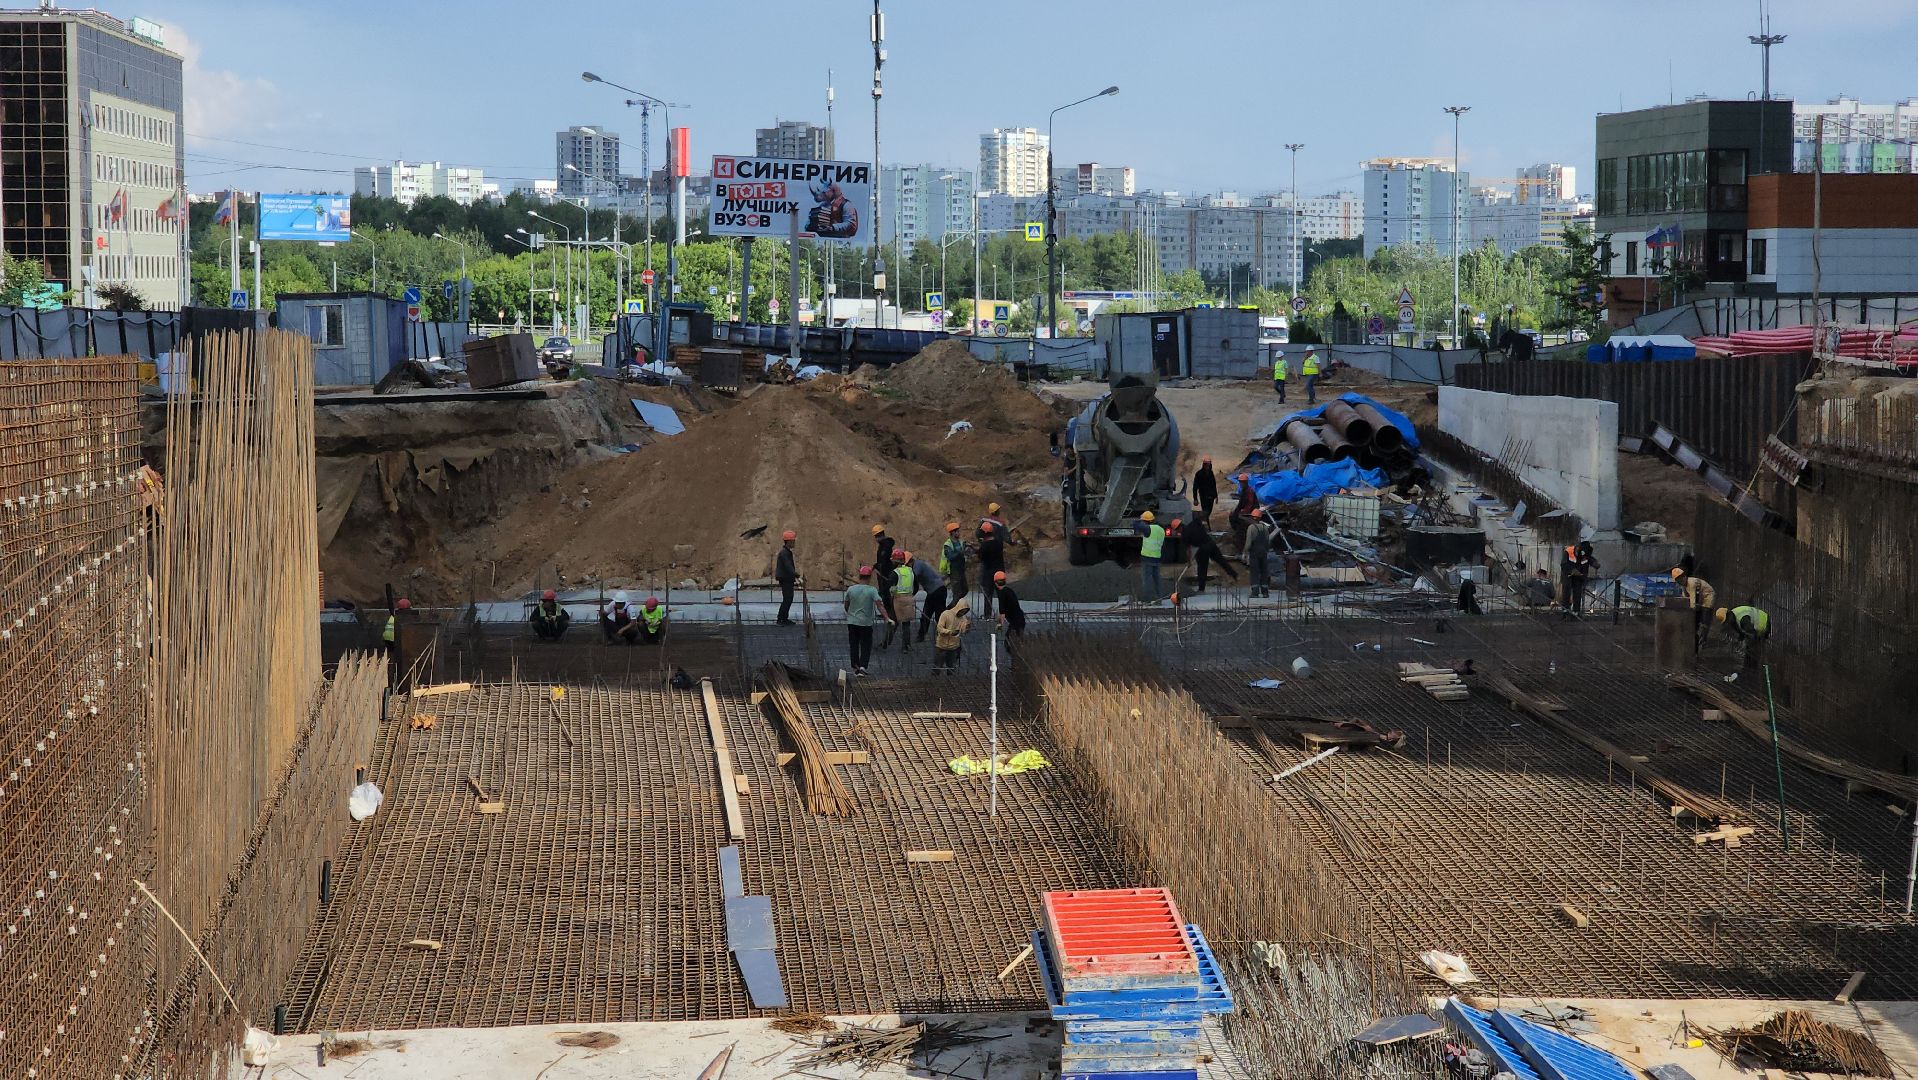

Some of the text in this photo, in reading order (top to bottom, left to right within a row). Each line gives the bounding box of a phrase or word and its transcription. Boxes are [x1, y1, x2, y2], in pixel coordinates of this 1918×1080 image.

[736, 161, 868, 184] СИНЕРГИЯ
[716, 184, 726, 197] В
[714, 213, 771, 227] ВУЗОВ
